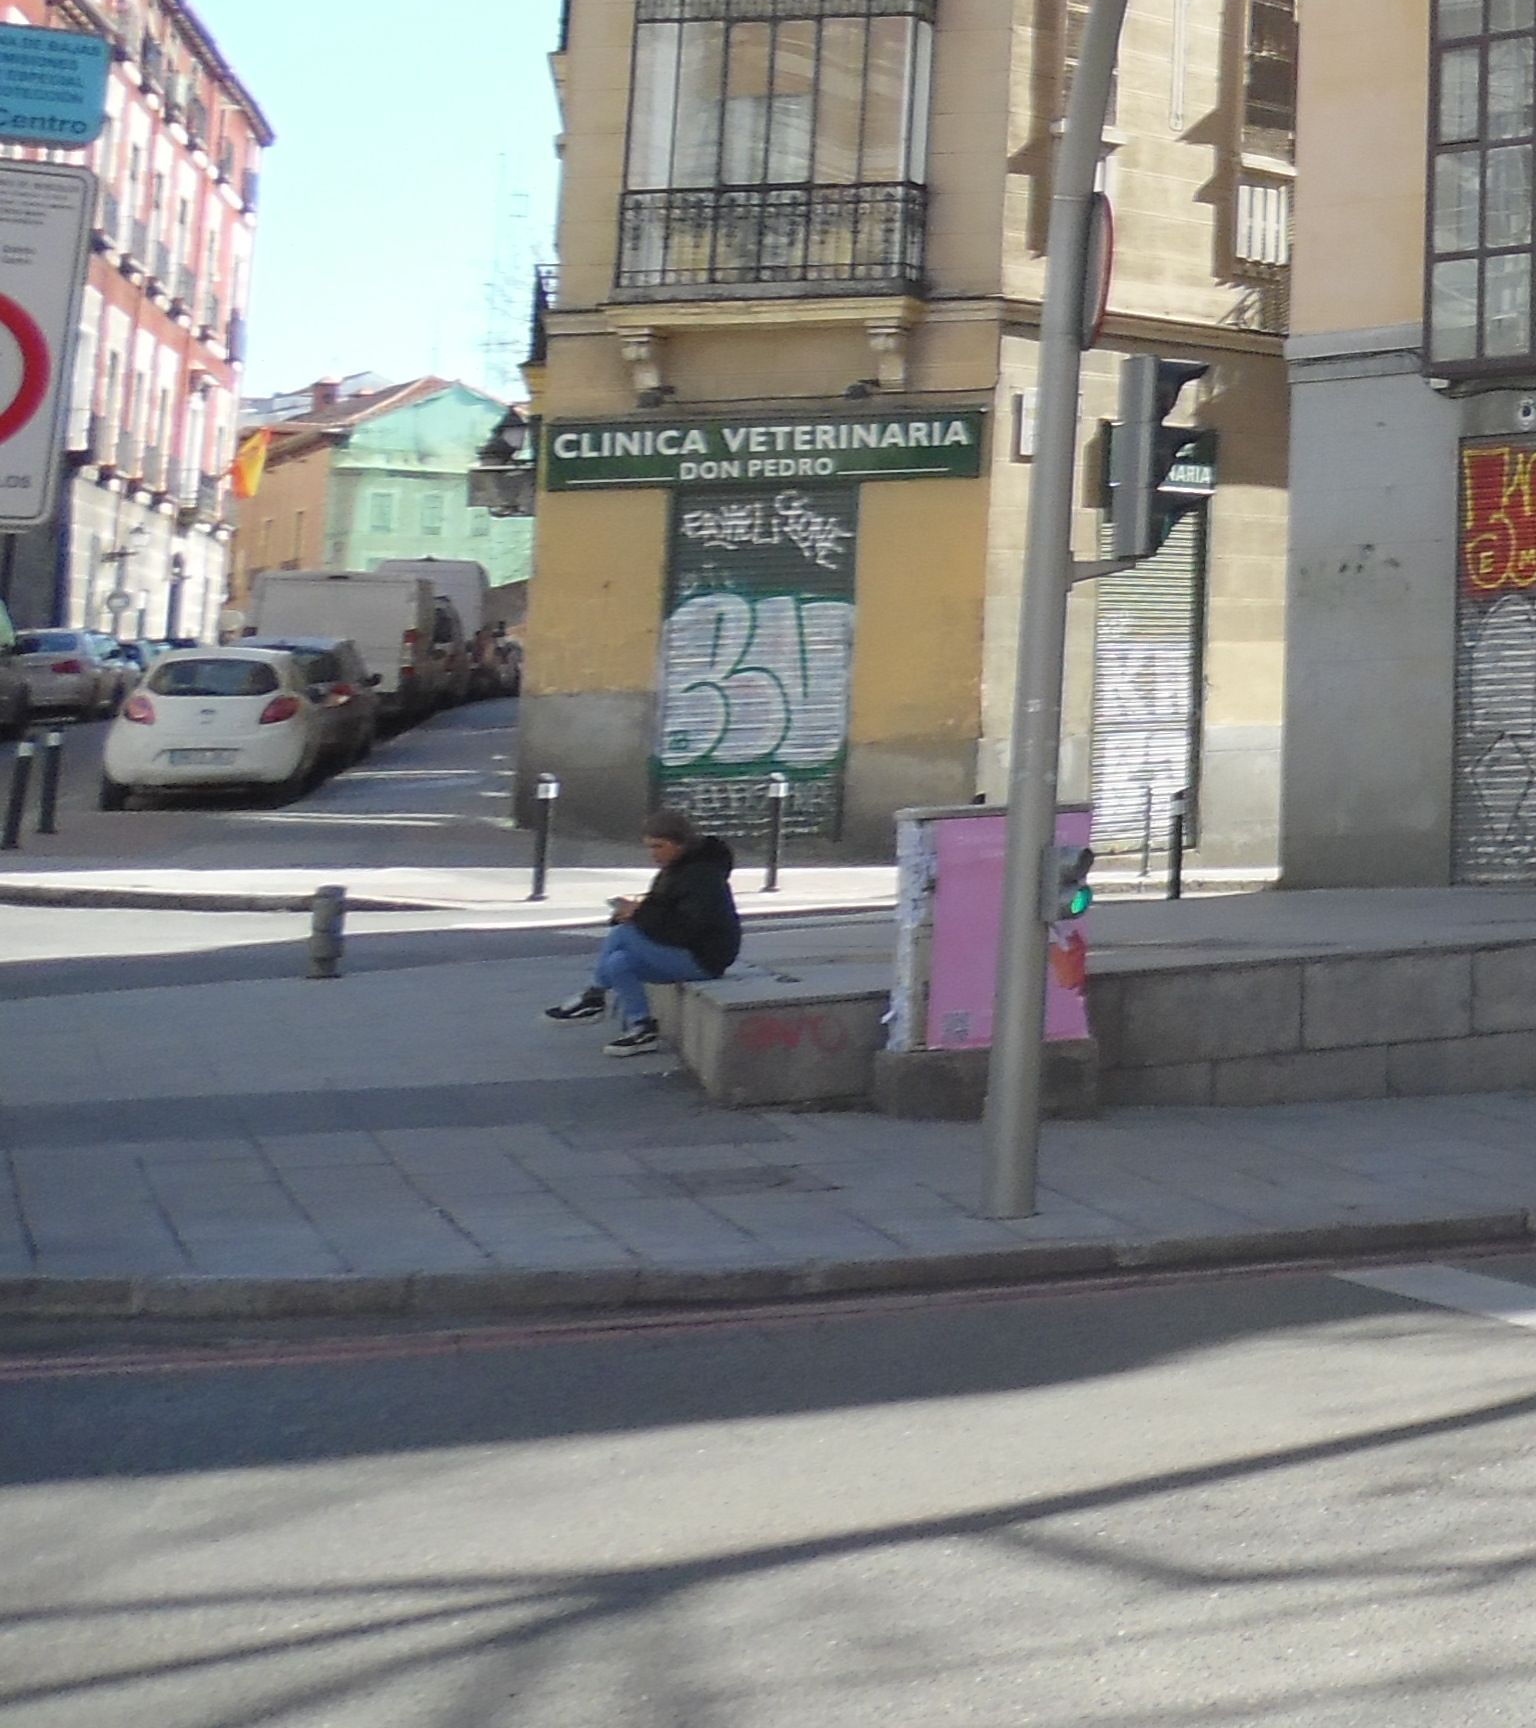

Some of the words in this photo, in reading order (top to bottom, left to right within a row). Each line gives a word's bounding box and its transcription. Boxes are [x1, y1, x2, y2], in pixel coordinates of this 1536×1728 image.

[553, 429, 706, 459] CLINICA
[722, 420, 972, 453] VETERINARIA
[680, 459, 740, 481] DON
[747, 457, 834, 479] PEDRO
